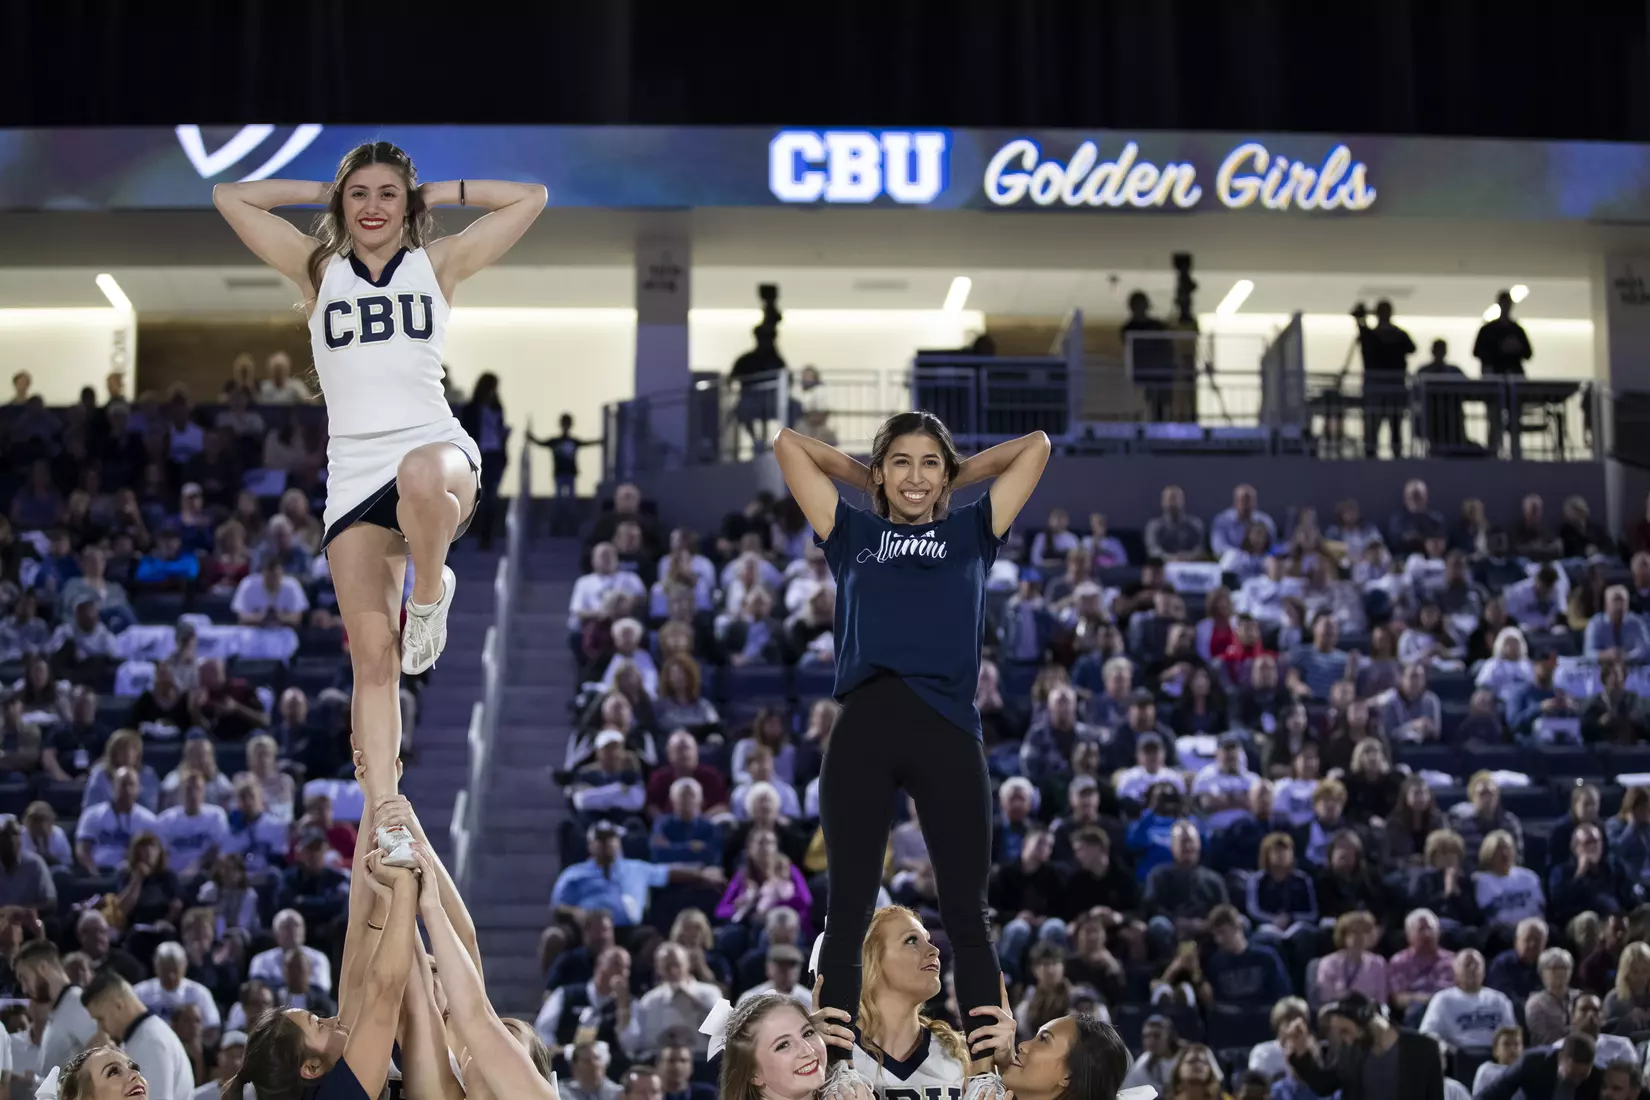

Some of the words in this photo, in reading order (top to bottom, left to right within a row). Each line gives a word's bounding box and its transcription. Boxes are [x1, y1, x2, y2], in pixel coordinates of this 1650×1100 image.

[769, 131, 946, 203] CBU
[984, 139, 1202, 207] Golden
[1215, 142, 1377, 210] Girls
[323, 292, 434, 351] CBU
